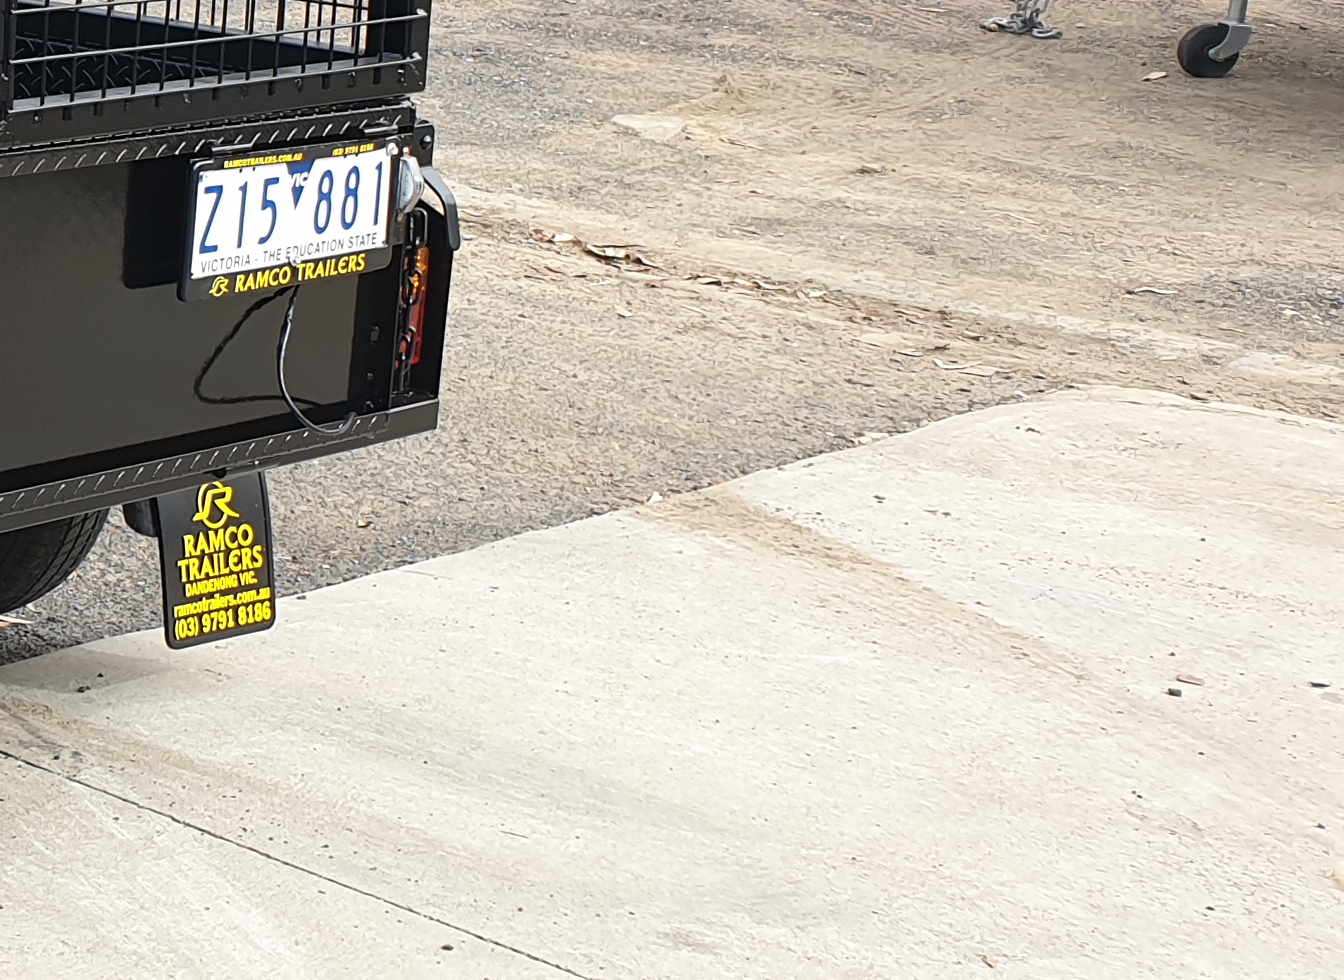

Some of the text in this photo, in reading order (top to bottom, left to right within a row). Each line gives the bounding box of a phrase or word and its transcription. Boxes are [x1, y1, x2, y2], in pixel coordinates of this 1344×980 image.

[199, 161, 384, 255] Z15 VIC 881
[200, 255, 251, 273] VICTORIA
[262, 248, 282, 263] THE
[286, 237, 344, 261] EDUCATION
[348, 232, 378, 251] STATE
[234, 266, 291, 293] RAMCO
[296, 253, 366, 282] TRAILERS
[183, 524, 254, 558] RAMCO
[177, 545, 263, 583] TRAILERS
[174, 587, 271, 618] ramcotrailers.com.au
[185, 570, 258, 597] DANDENONG VIC.
[175, 601, 272, 640] (03) 9791 8186
